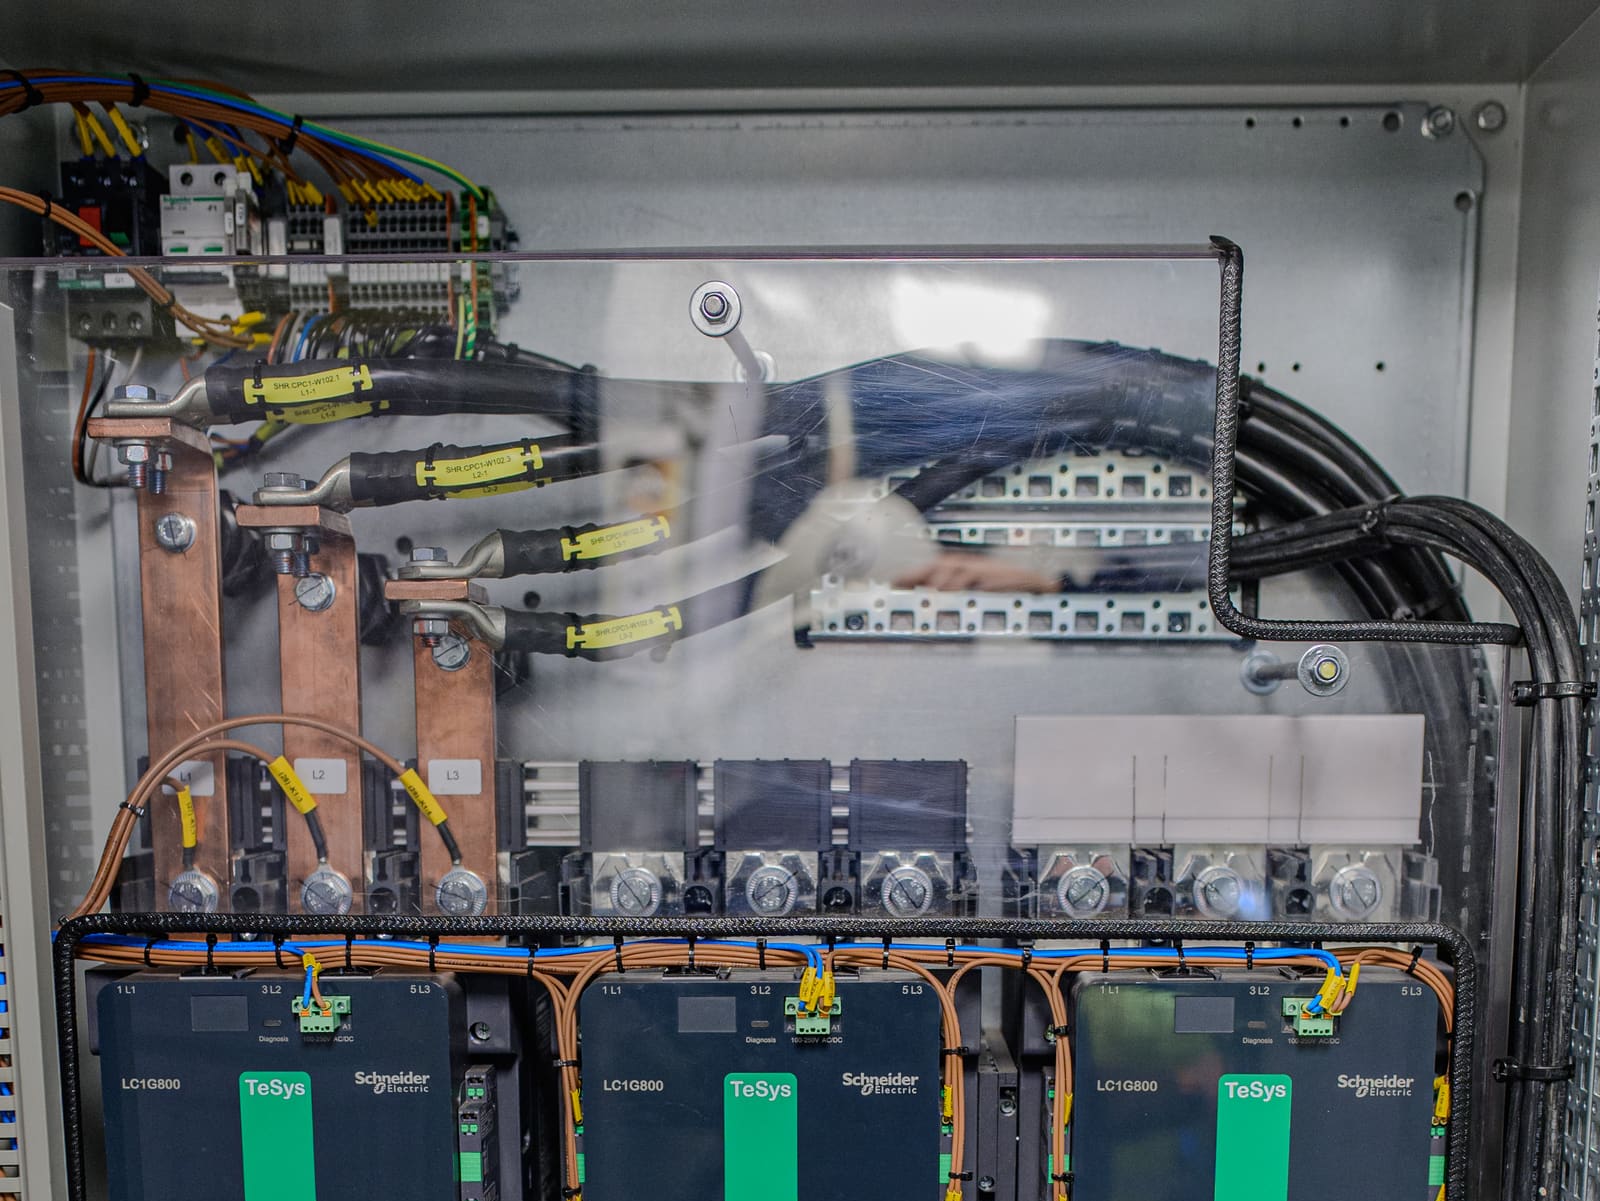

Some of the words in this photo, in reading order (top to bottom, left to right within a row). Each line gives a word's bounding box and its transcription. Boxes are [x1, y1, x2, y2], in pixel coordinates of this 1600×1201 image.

[300, 388, 316, 397] L1-1
[472, 470, 488, 479] L2-1
[180, 771, 192, 782] L1
[312, 769, 325, 780] L2
[446, 770, 460, 781] L3
[125, 985, 136, 994] L1
[269, 985, 282, 994] L2
[418, 984, 431, 994] L3
[610, 985, 622, 995] L1
[758, 985, 771, 995] L2
[910, 985, 923, 995] L3
[1108, 985, 1119, 995] L1
[1257, 986, 1270, 996] L2
[1409, 986, 1423, 996] L3
[258, 1035, 289, 1044] Diagnosis
[745, 1036, 777, 1045] Diagnosis
[1242, 1036, 1274, 1045] Diagnosis
[354, 1071, 431, 1084] Schneider
[842, 1072, 920, 1086] Schneider
[1337, 1074, 1415, 1087] Schneider
[121, 1078, 181, 1090] LC1G800
[245, 1079, 305, 1099] TeSys
[387, 1083, 429, 1093] Electric
[603, 1079, 664, 1092] LC1G800
[1096, 1079, 1158, 1092] LC1G800
[730, 1081, 791, 1101] TeSys
[874, 1085, 917, 1095] Electric
[1225, 1081, 1286, 1102] TeSys
[1369, 1086, 1412, 1097] Electric
